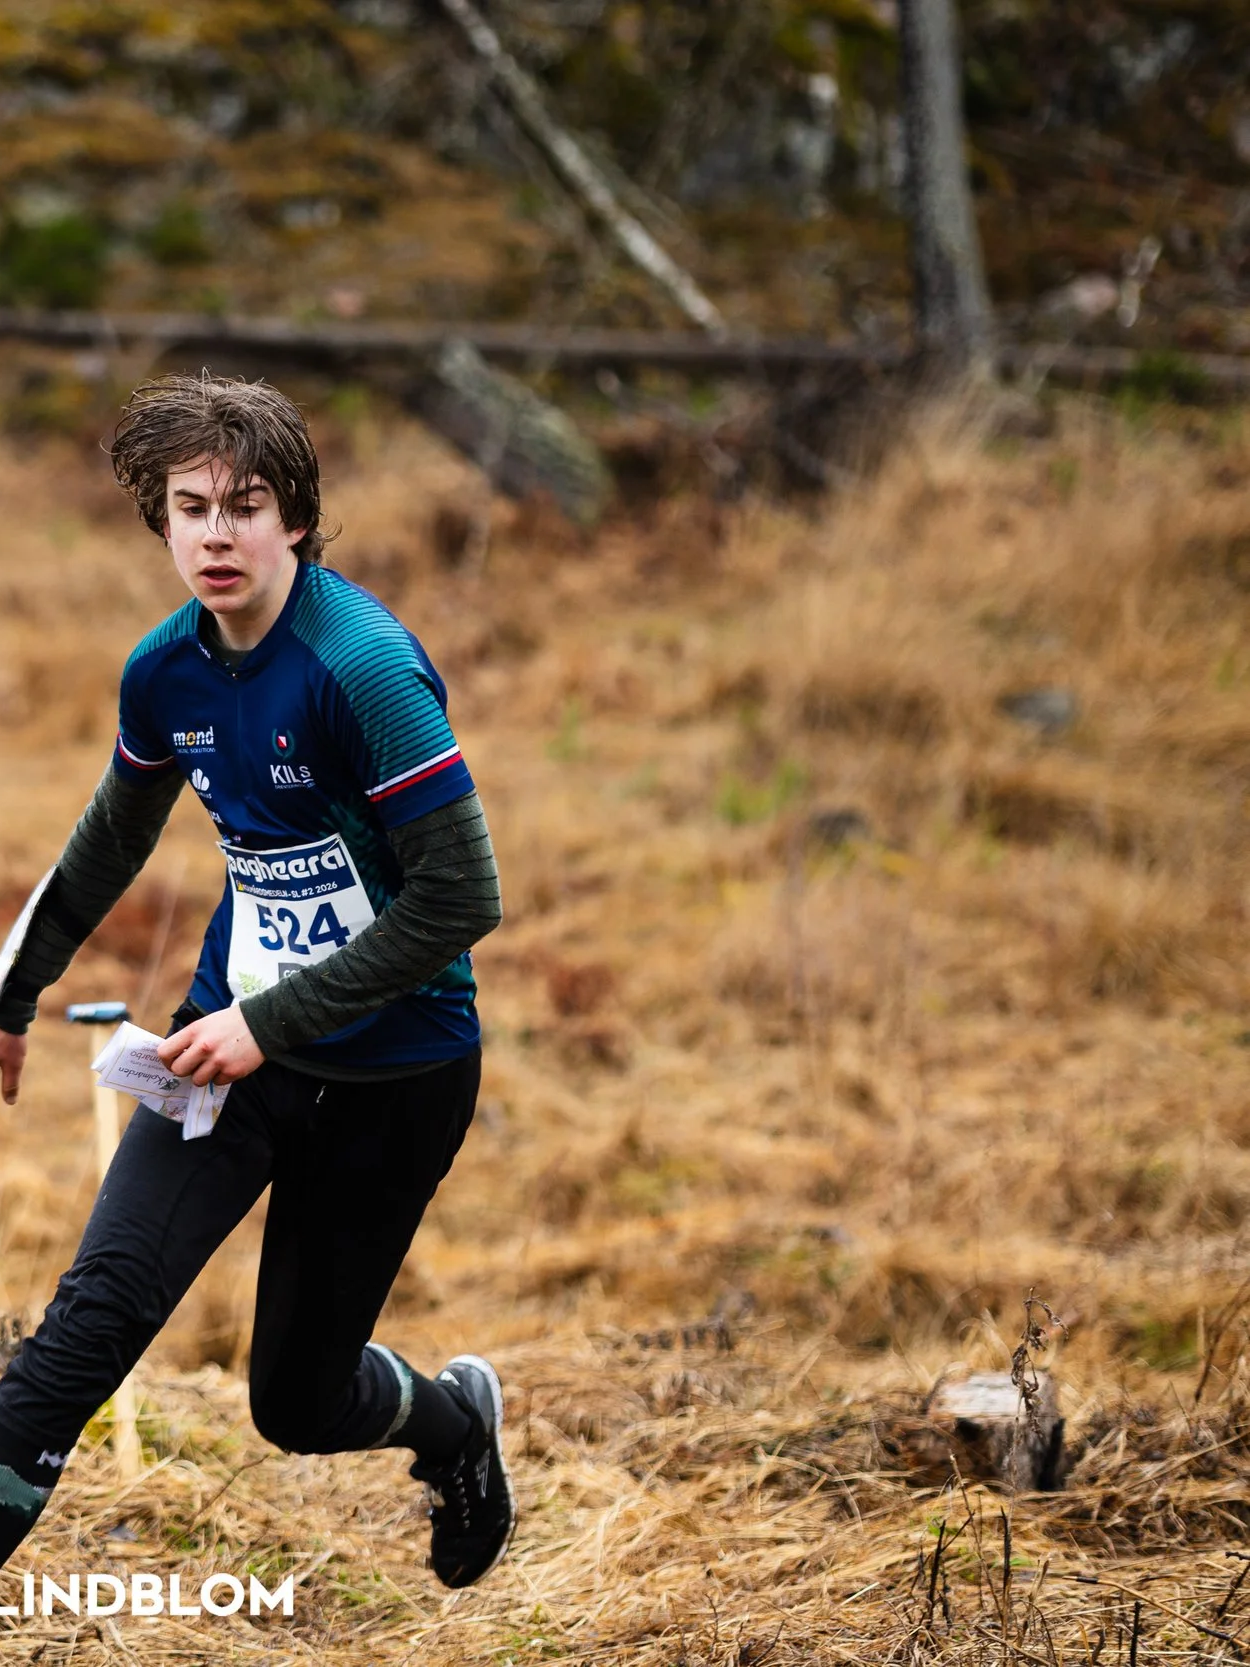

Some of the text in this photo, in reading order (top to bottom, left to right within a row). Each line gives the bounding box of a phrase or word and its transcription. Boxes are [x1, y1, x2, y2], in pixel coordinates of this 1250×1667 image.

[173, 725, 214, 746] mond
[270, 764, 312, 785] KILS
[315, 881, 338, 894] 2026
[256, 901, 351, 956] 524
